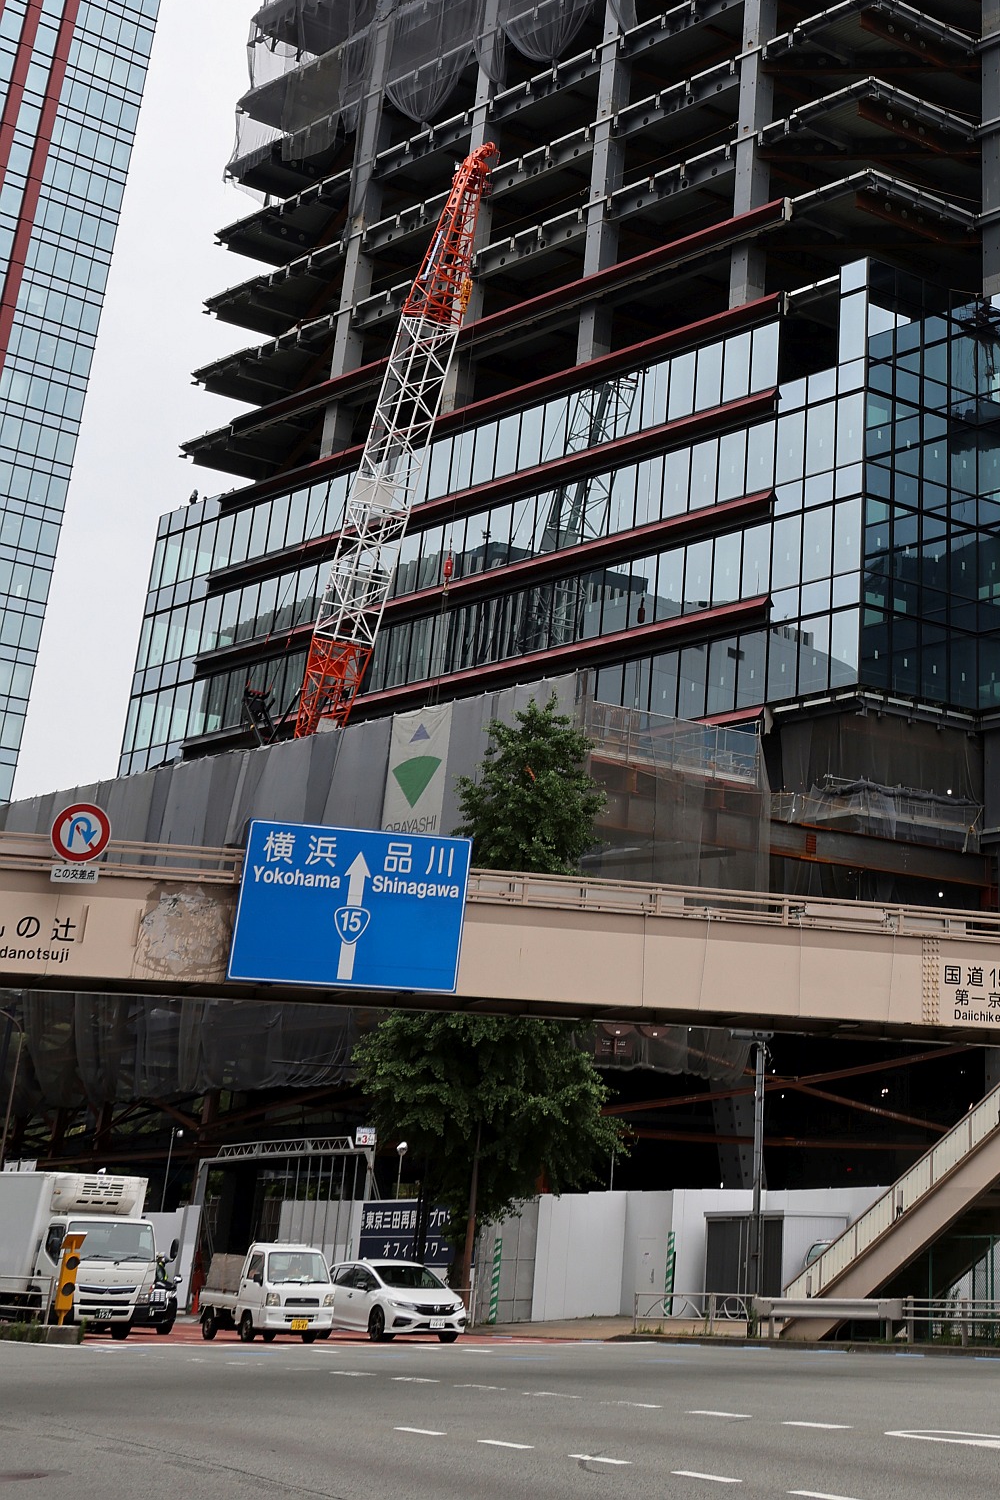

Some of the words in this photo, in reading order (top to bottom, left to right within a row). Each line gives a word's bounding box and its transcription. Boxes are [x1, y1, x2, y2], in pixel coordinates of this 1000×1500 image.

[263, 831, 337, 867] 横浜
[384, 842, 455, 877] 品川
[53, 868, 96, 880] この交差点
[253, 865, 341, 889] Yokohama
[372, 875, 460, 899] Shinagawa
[340, 911, 362, 933] 15
